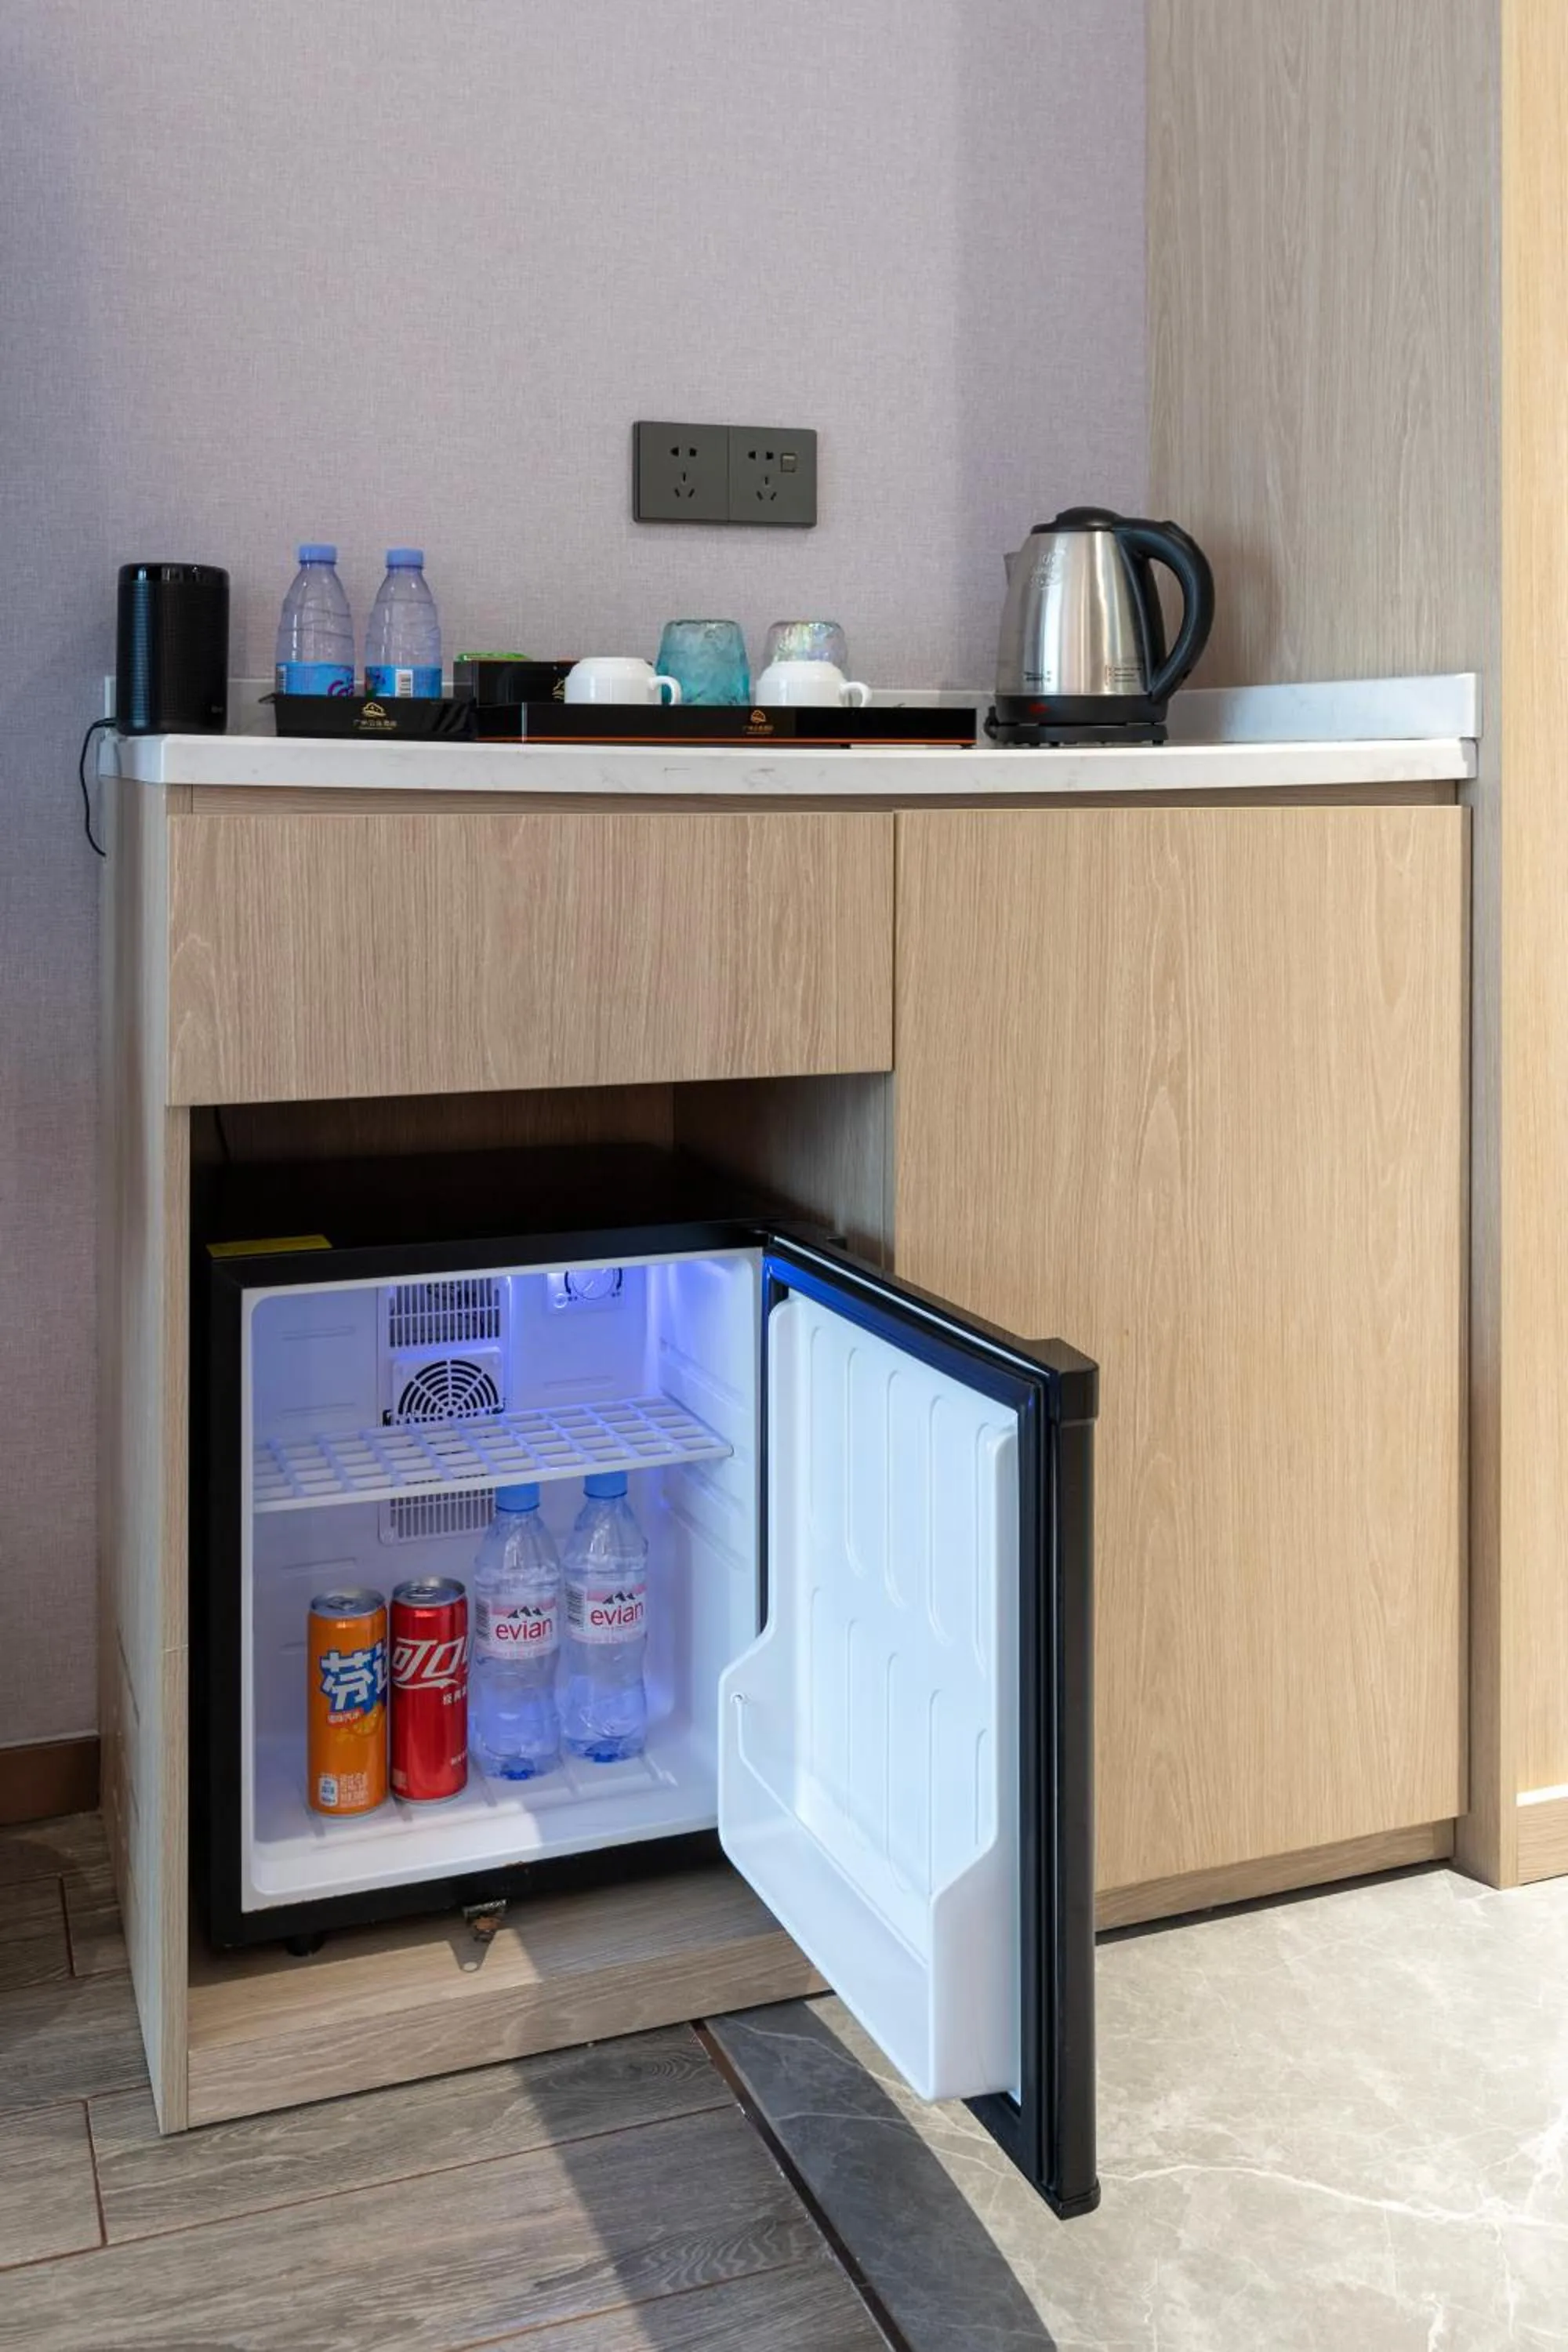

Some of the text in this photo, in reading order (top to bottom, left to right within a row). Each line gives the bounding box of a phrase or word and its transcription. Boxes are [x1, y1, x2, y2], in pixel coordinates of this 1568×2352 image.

[590, 1601, 644, 1625] evian
[495, 1617, 553, 1640] evian
[393, 1636, 468, 1684] 可口
